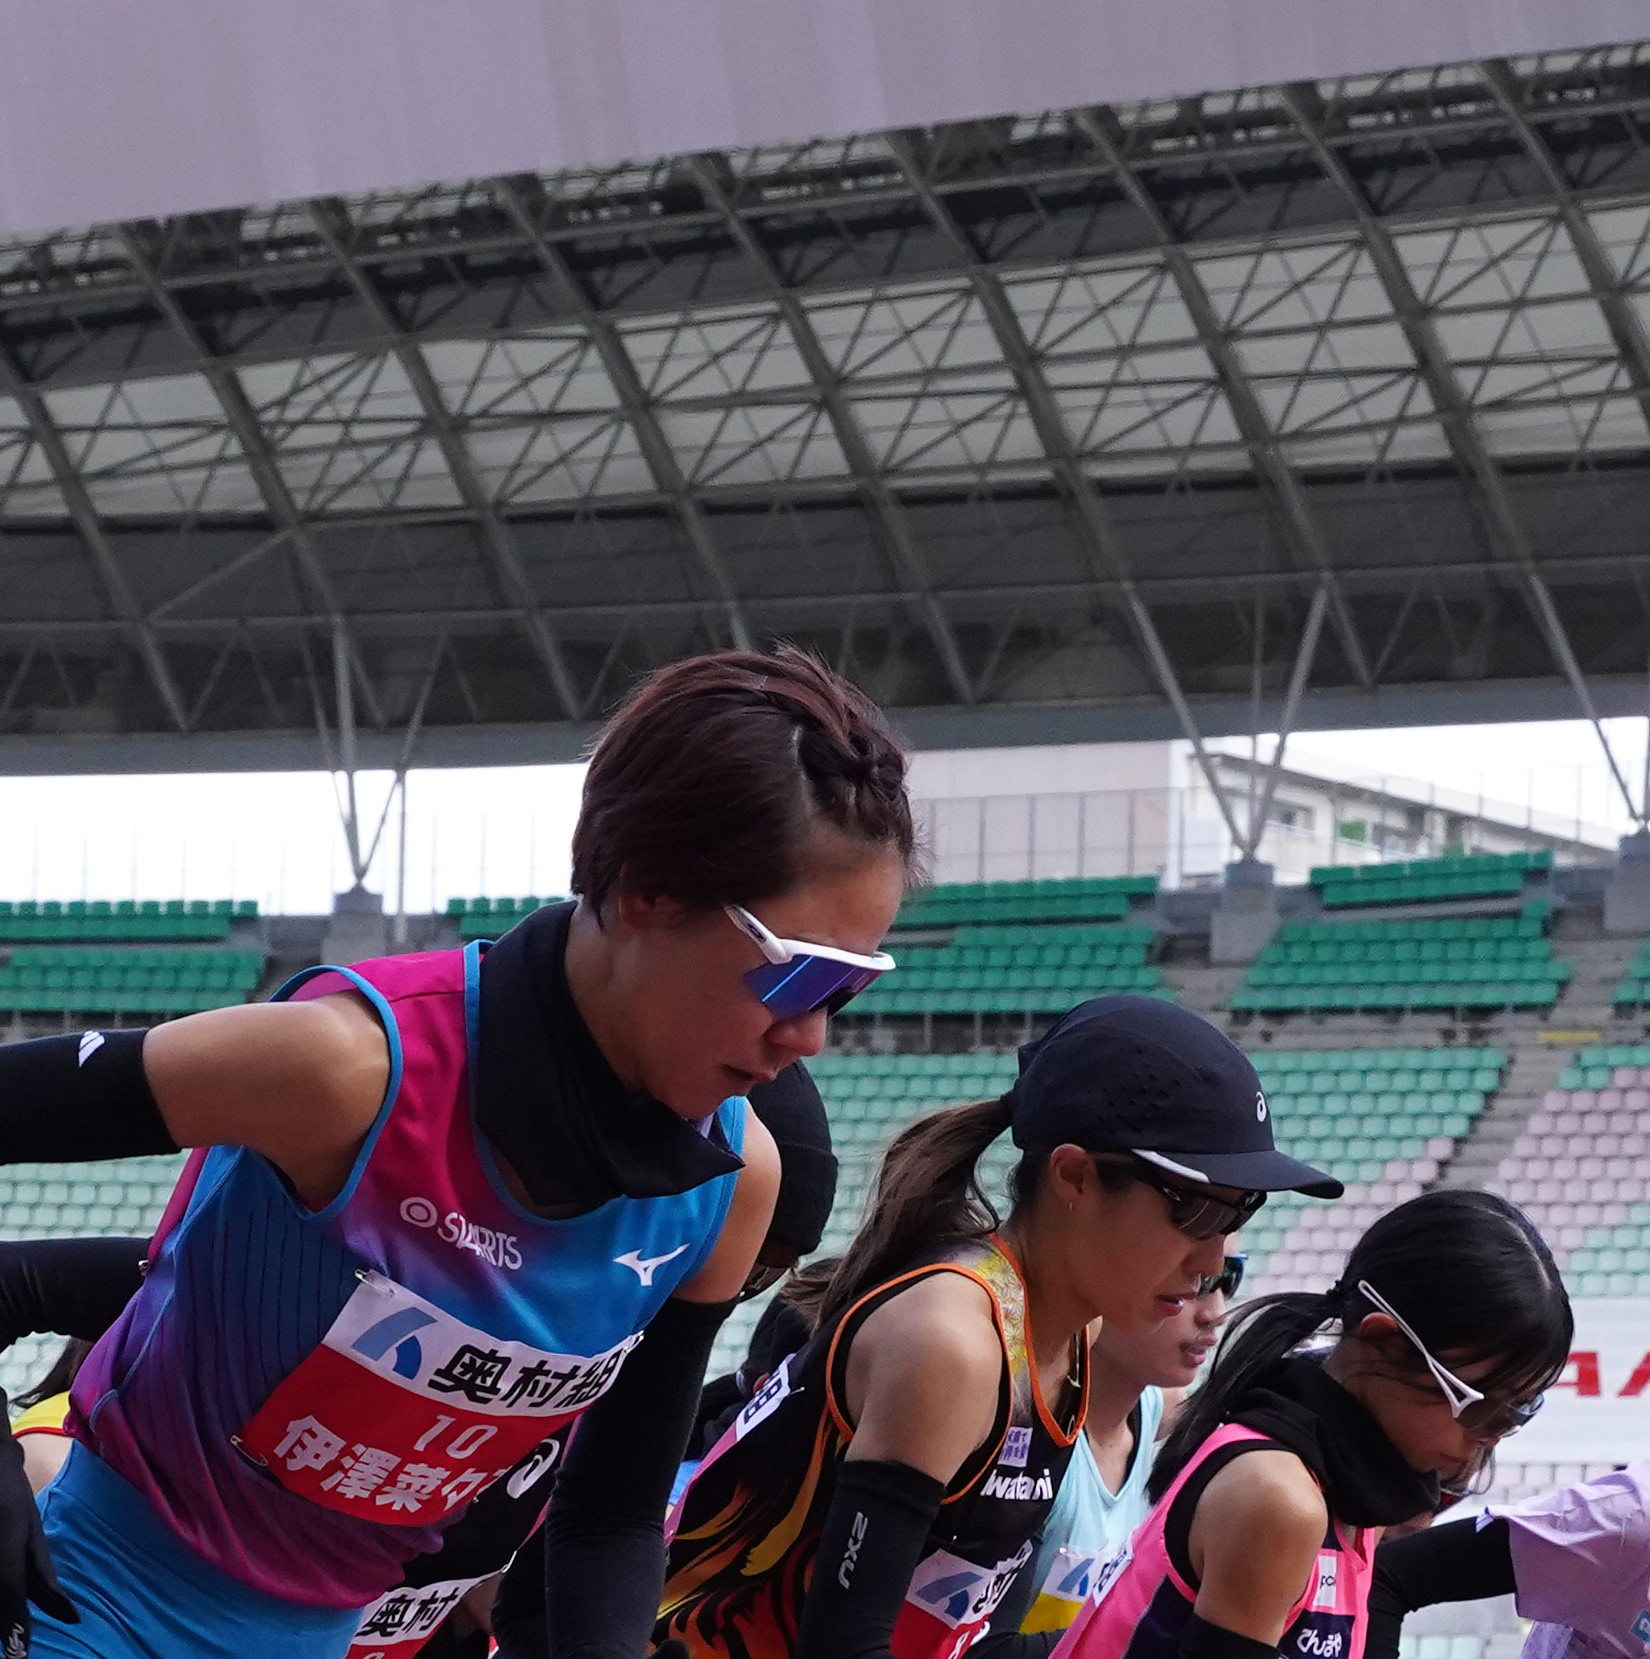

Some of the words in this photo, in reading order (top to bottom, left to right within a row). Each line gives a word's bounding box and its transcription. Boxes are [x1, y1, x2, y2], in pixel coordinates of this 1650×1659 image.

[427, 1343, 624, 1410] 奥村組
[412, 1413, 499, 1460] 10
[979, 1467, 1054, 1501] Iwatani
[837, 1510, 869, 1591] 2XU
